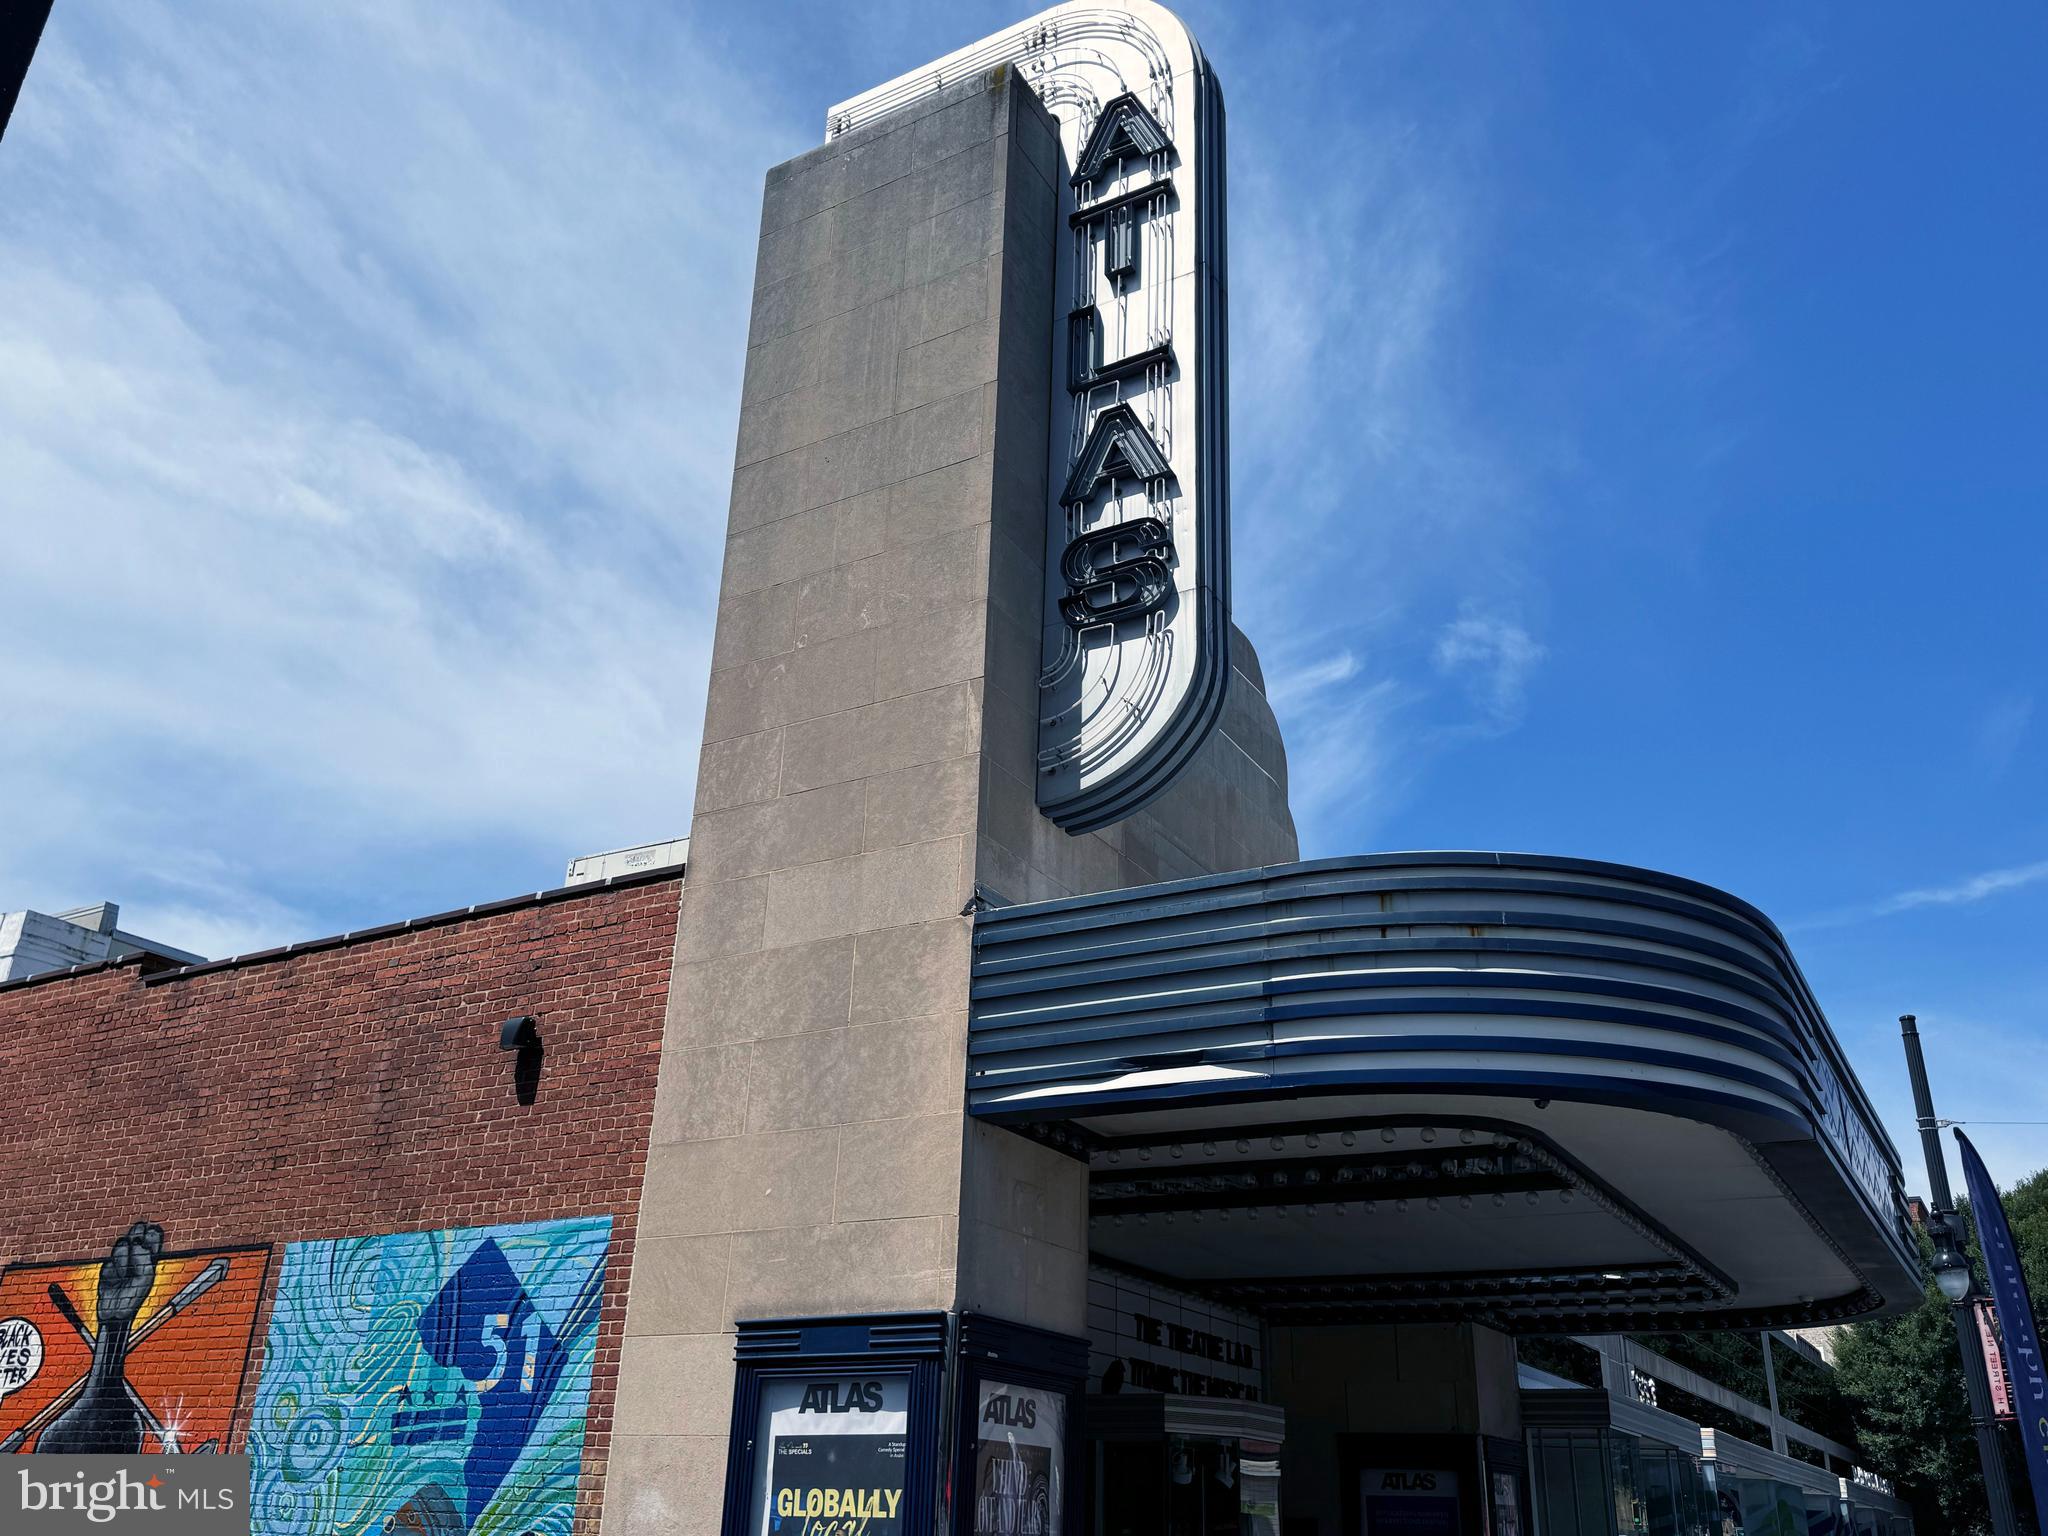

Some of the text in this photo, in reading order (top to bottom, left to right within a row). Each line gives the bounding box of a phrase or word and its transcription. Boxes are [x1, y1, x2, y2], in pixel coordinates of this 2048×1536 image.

[1059, 91, 1178, 630] ATLAS
[798, 1381, 883, 1414] ATLAS
[983, 1393, 1036, 1429] ATLAS
[1381, 1472, 1437, 1490] ATLAS
[777, 1488, 903, 1519] GLOBALLY
